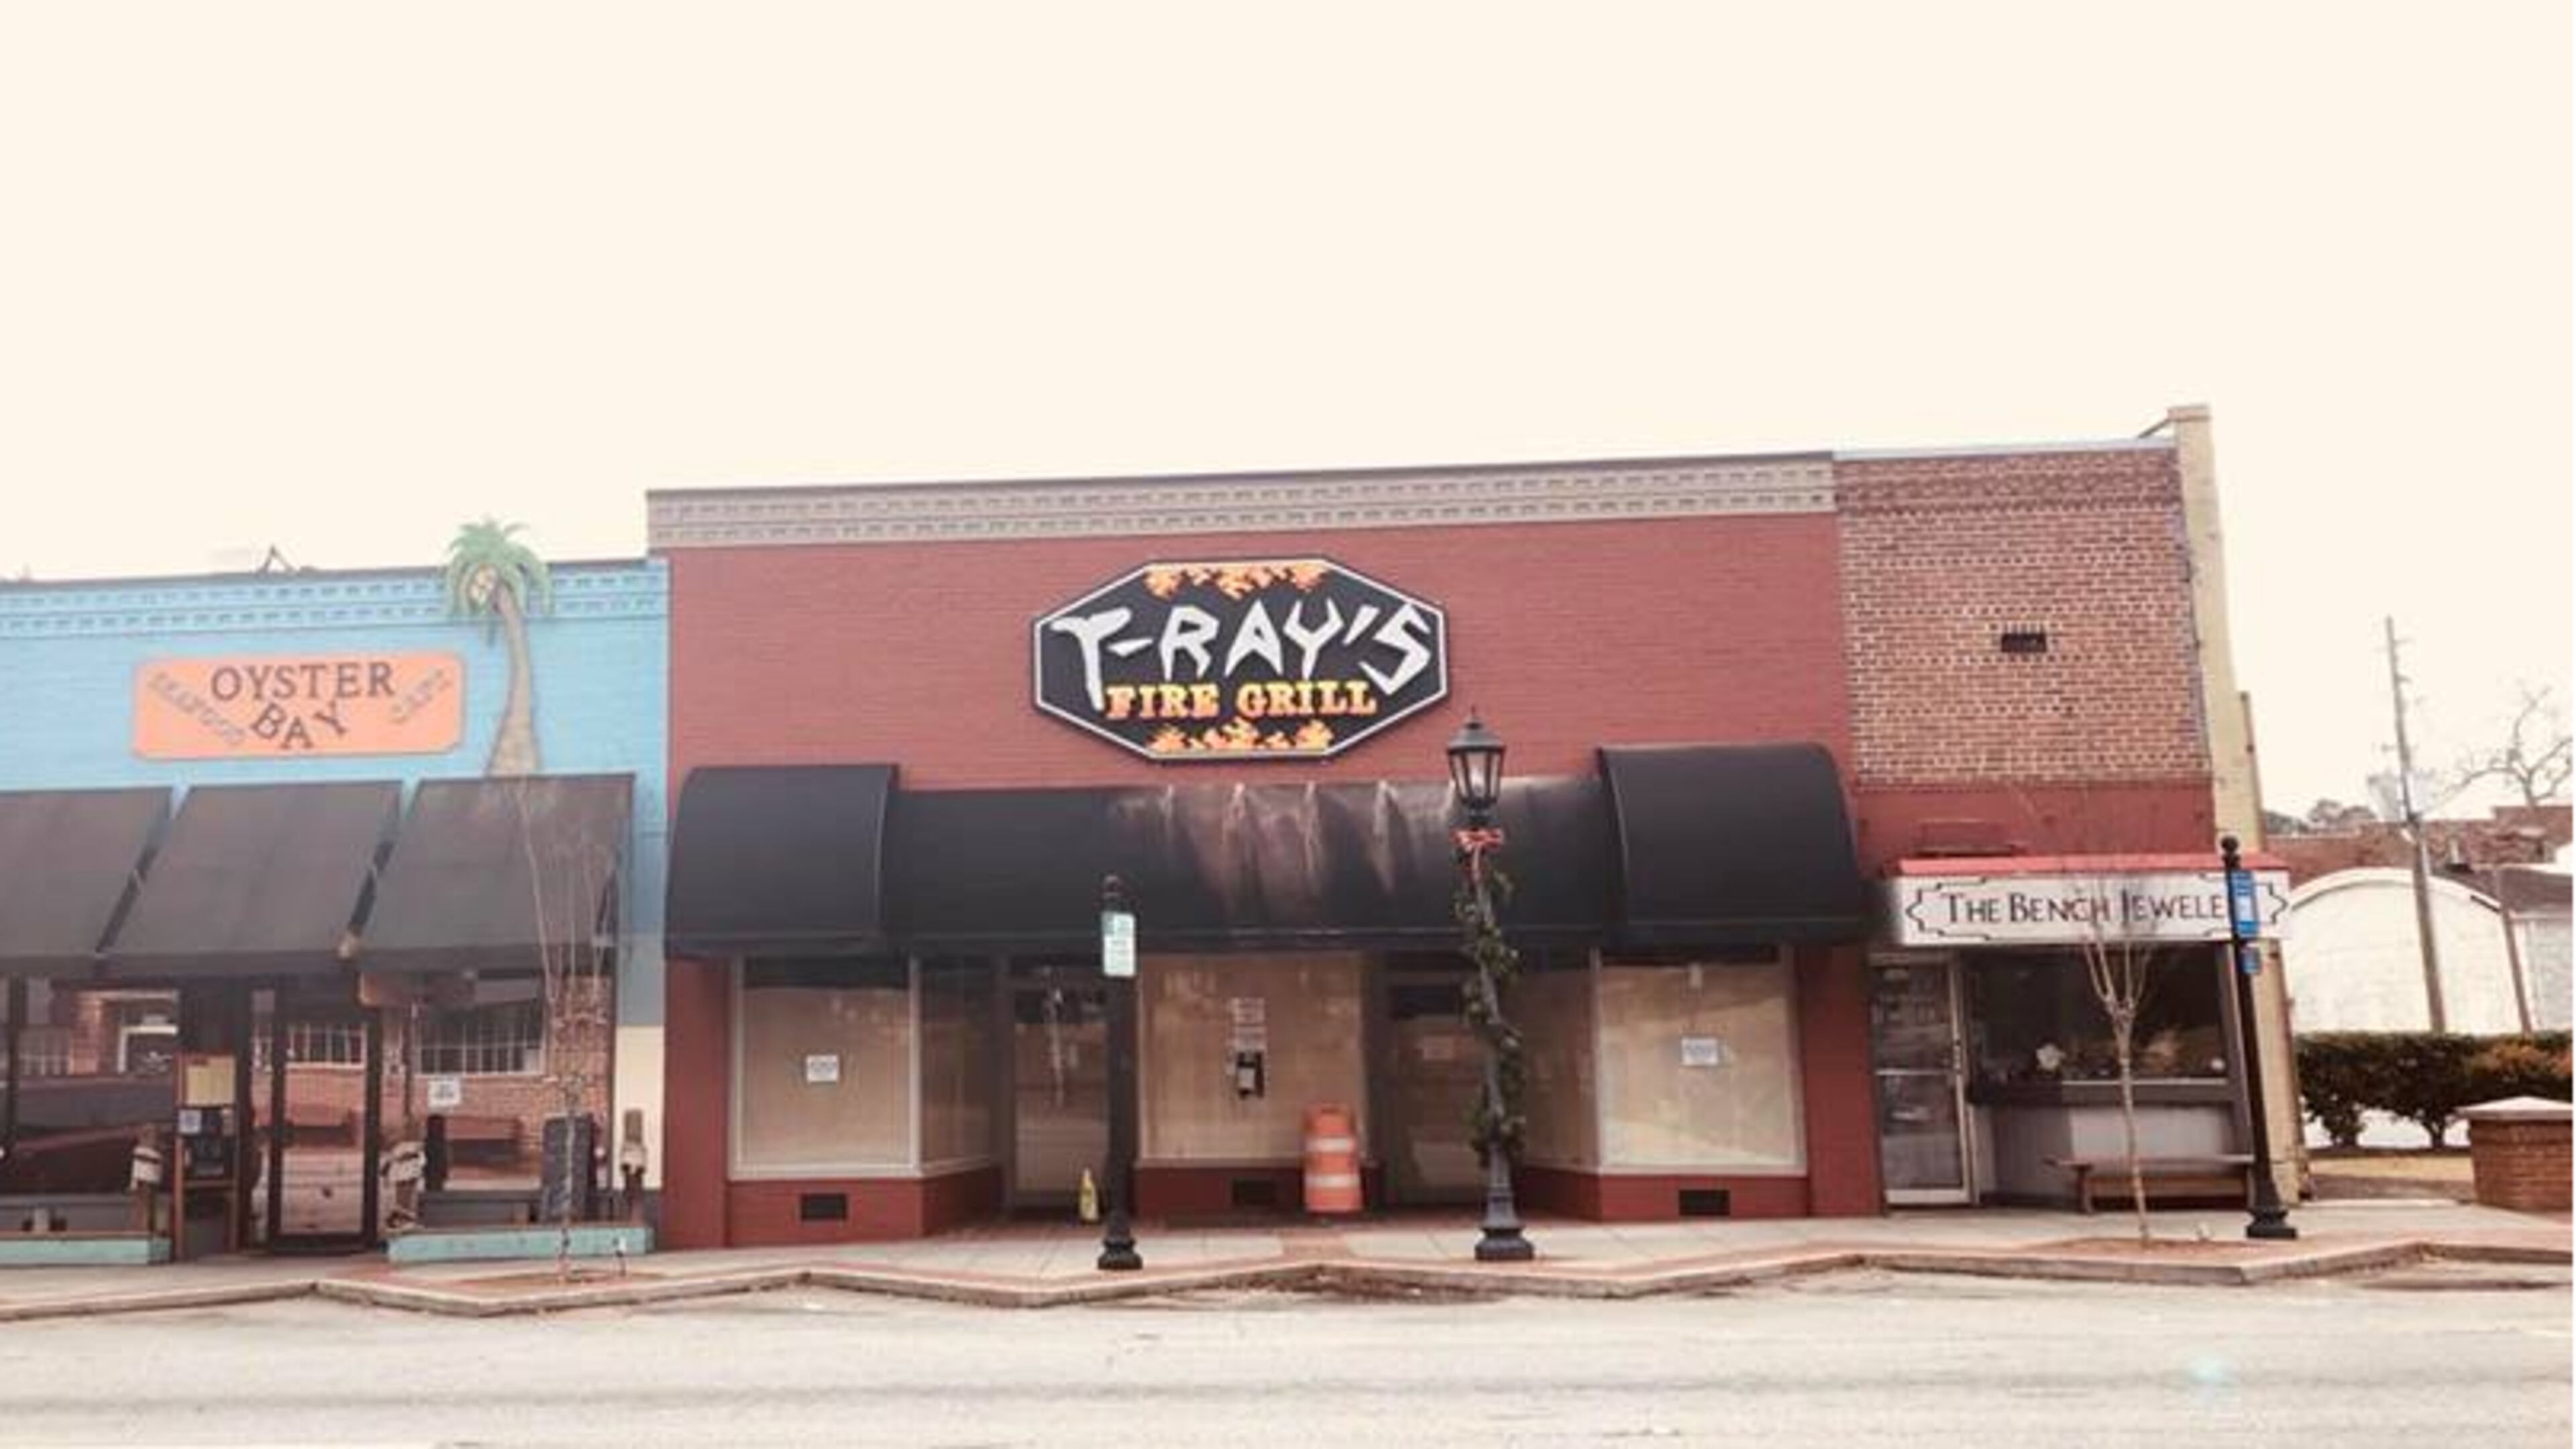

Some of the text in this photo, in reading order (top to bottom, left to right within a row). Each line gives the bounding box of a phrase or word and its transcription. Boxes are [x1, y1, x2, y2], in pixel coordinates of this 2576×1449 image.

[1051, 600, 1432, 711] T-RAY'S
[211, 661, 394, 702] OYSTER
[1106, 679, 1377, 719] FIRE GRILL
[250, 700, 347, 750] BAY
[2121, 889, 2226, 924] JEWELE
